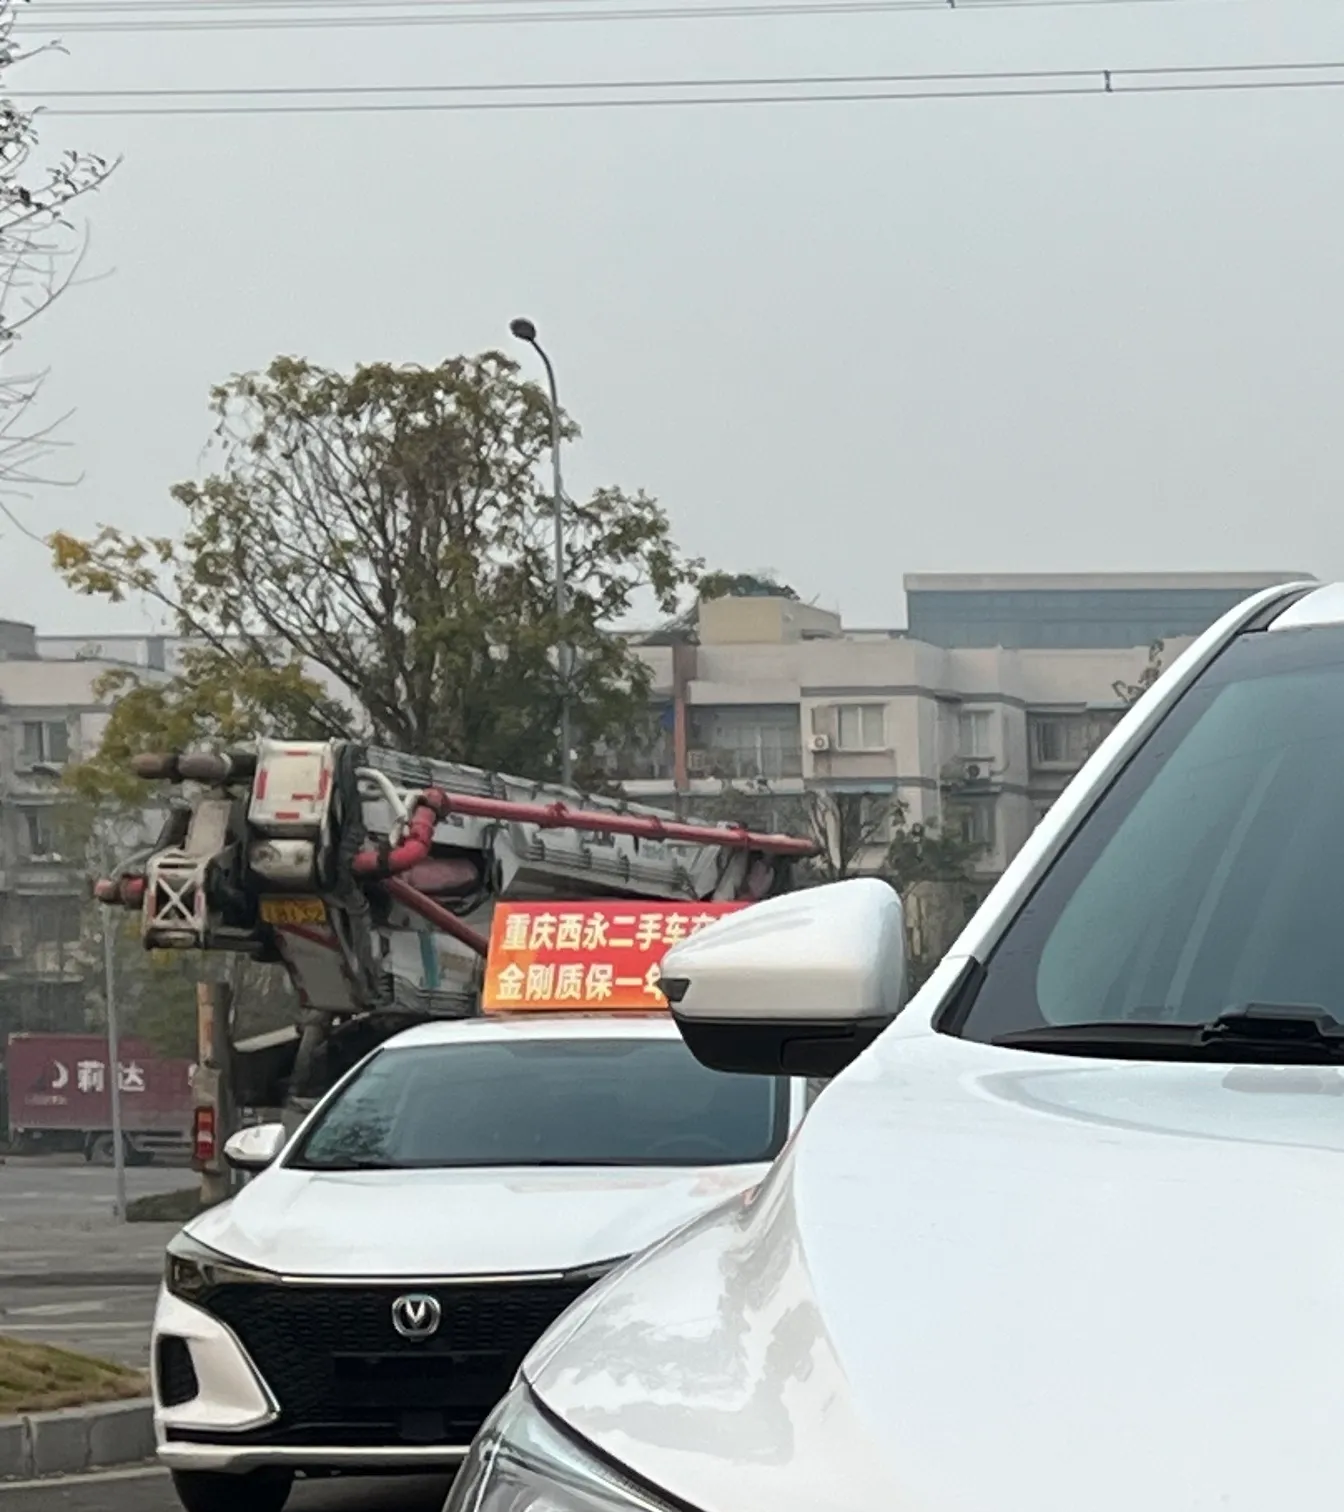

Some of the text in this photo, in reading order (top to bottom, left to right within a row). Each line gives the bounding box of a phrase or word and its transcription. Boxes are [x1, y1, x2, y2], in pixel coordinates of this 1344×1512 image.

[501, 911, 733, 951] 重庆西永二手车
